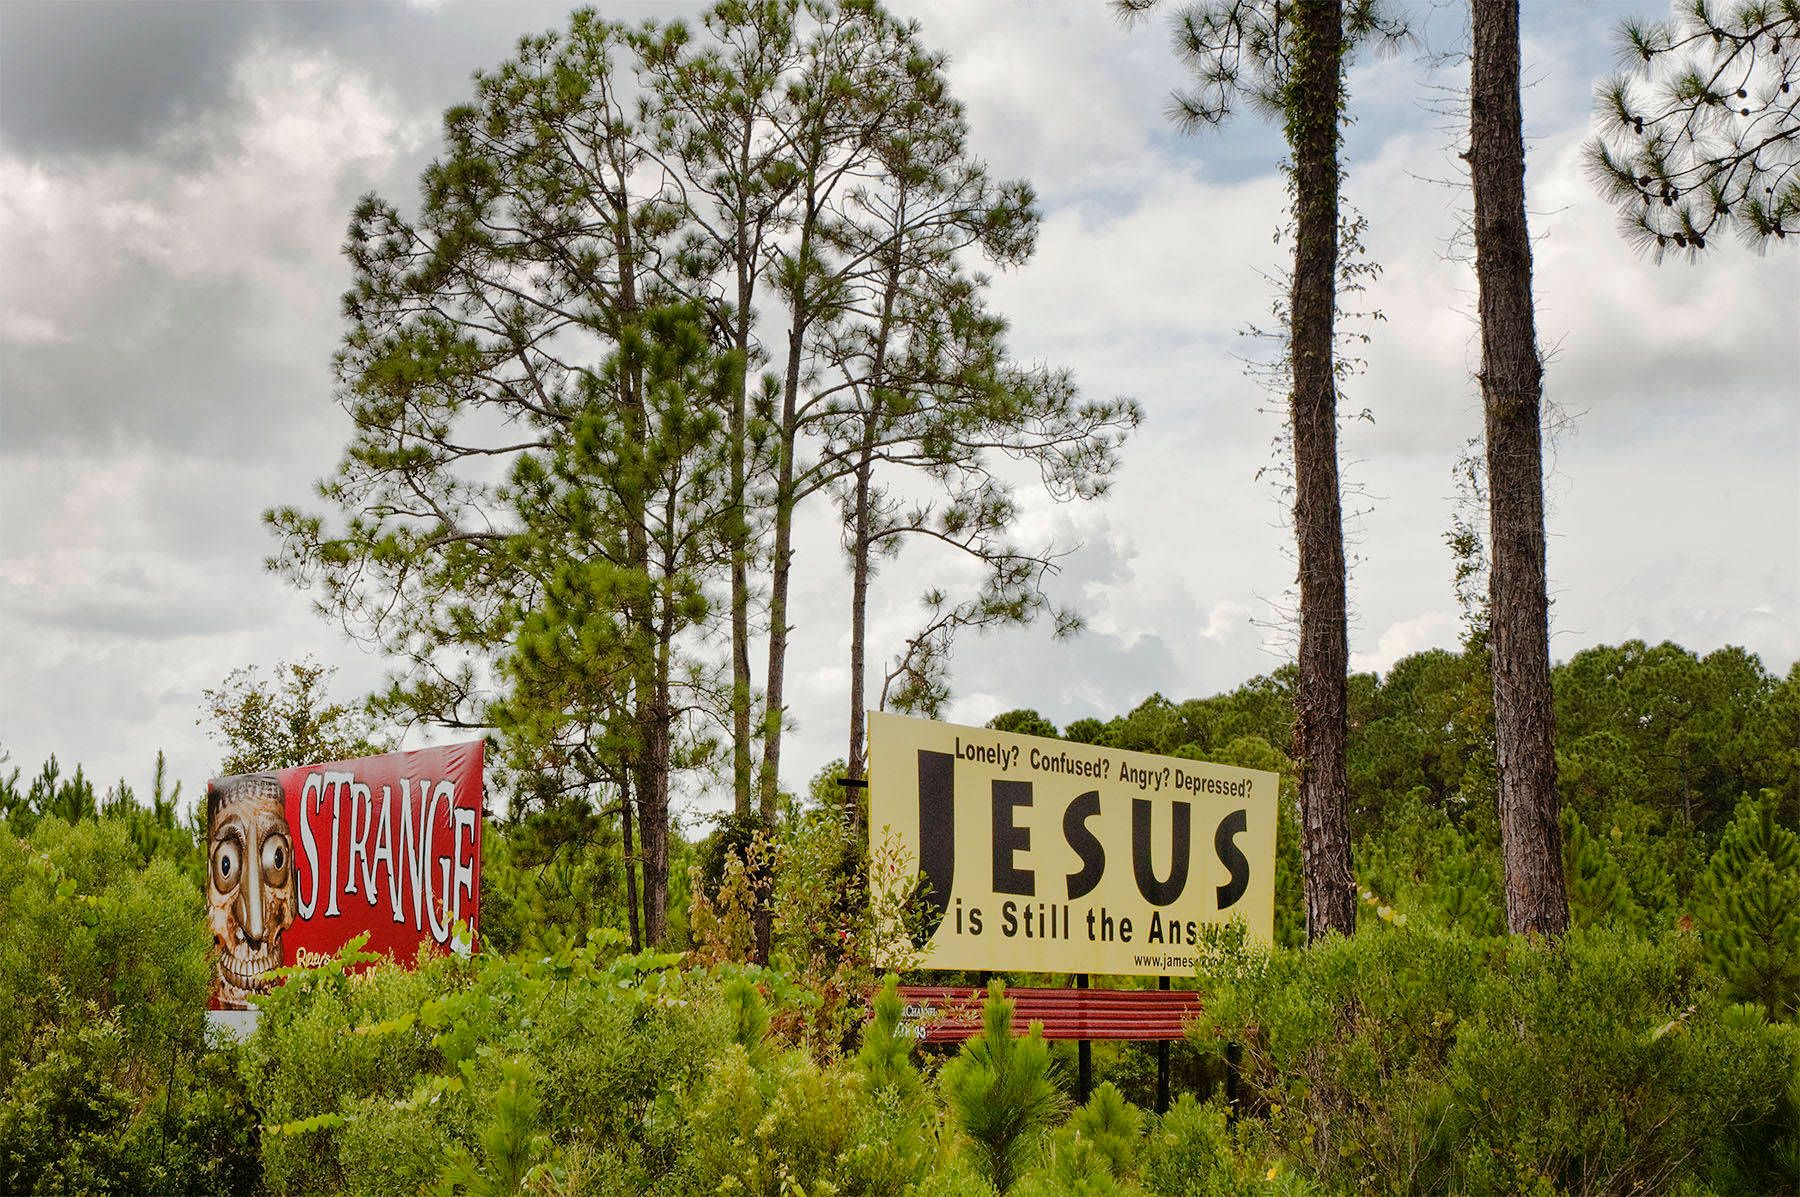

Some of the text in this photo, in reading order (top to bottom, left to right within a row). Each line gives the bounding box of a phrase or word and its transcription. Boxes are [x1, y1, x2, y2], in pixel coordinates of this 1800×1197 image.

[955, 737, 1253, 798] Lonely? Confused? Angry? Depressed?
[297, 771, 476, 959] STRANGE
[902, 749, 1251, 949] JESUS
[955, 898, 983, 935] is
[1002, 901, 1069, 940] Still
[1087, 907, 1133, 942] the
